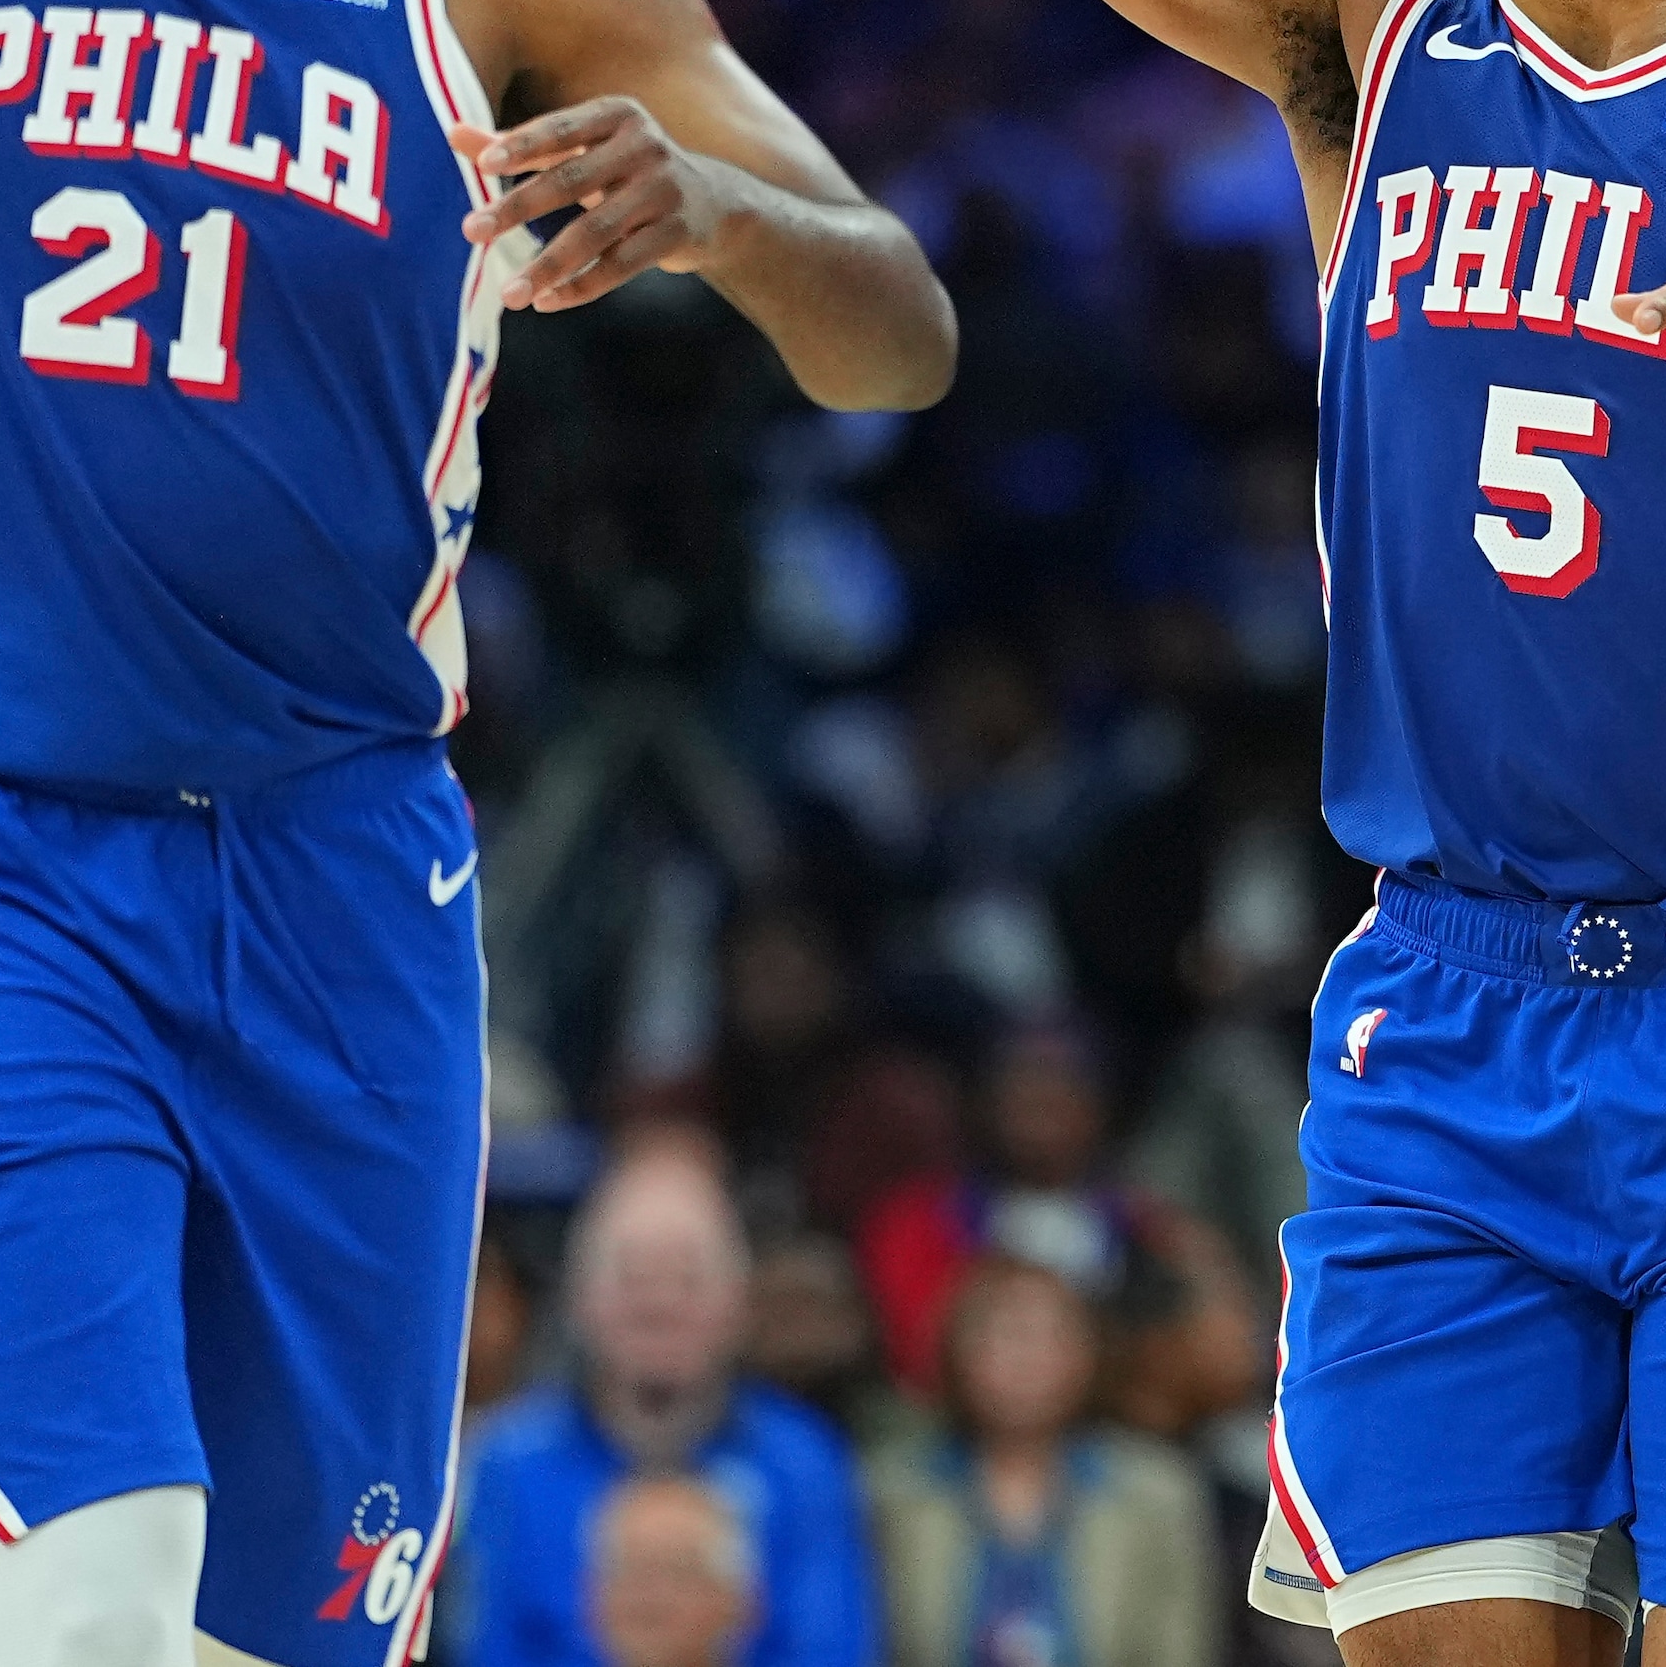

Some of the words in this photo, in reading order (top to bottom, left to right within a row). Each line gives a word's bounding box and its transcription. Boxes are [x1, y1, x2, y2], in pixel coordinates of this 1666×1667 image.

[20, 187, 247, 401] 21
[1472, 385, 1610, 600] 5
[317, 1527, 424, 1625] 76
